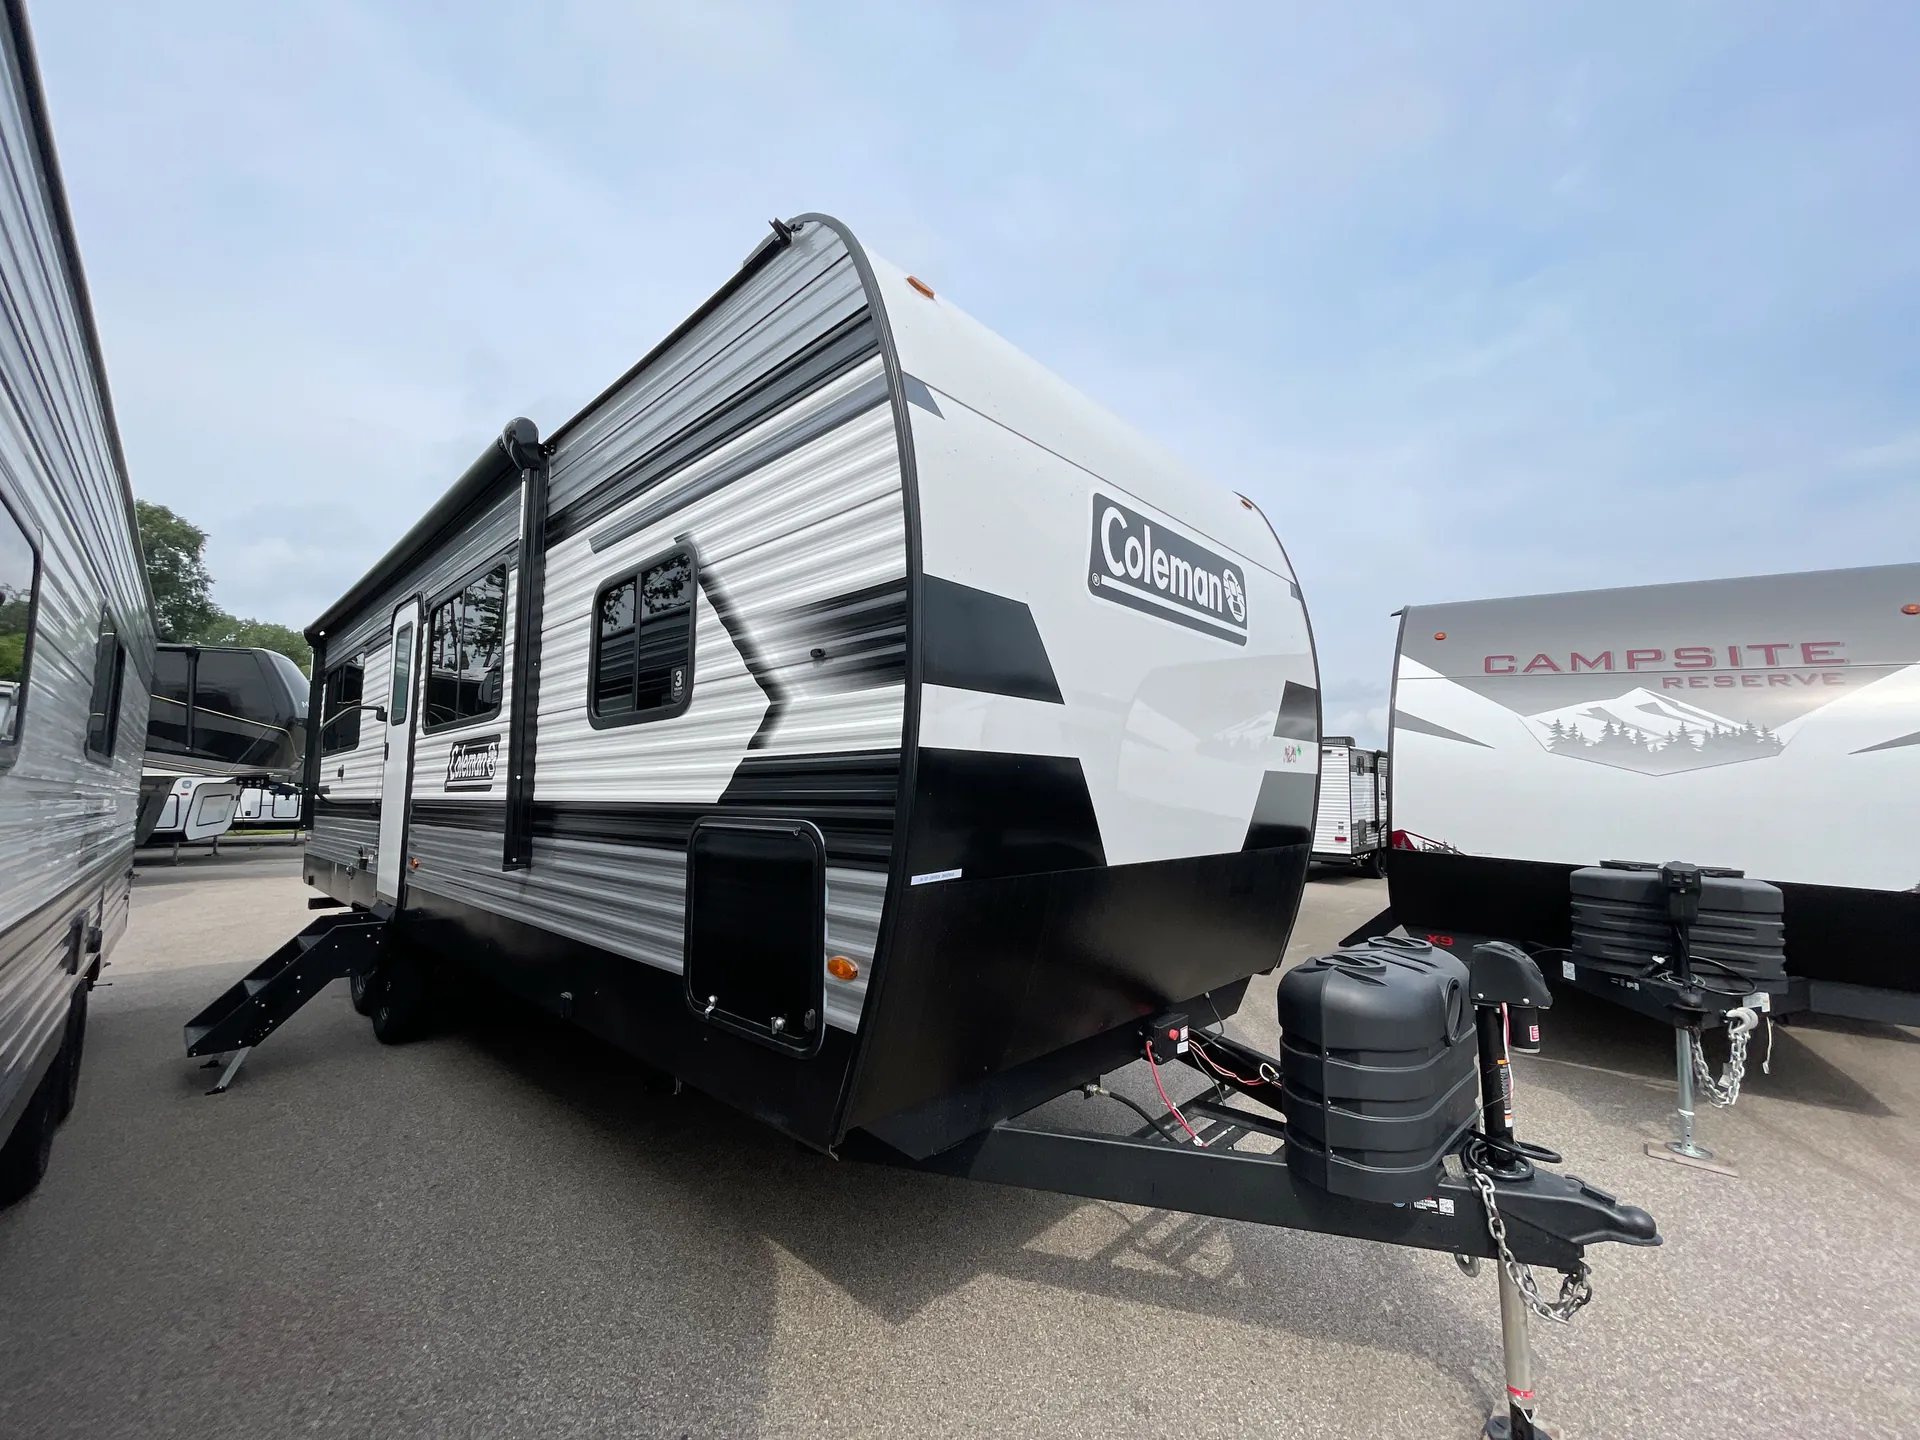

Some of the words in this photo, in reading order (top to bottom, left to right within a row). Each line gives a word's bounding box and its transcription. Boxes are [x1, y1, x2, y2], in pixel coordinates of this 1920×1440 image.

[1101, 506, 1223, 613] Coleman
[1484, 641, 1847, 674] CAMPSITE
[1662, 672, 1846, 690] RESERVE
[449, 744, 487, 780] Coleman
